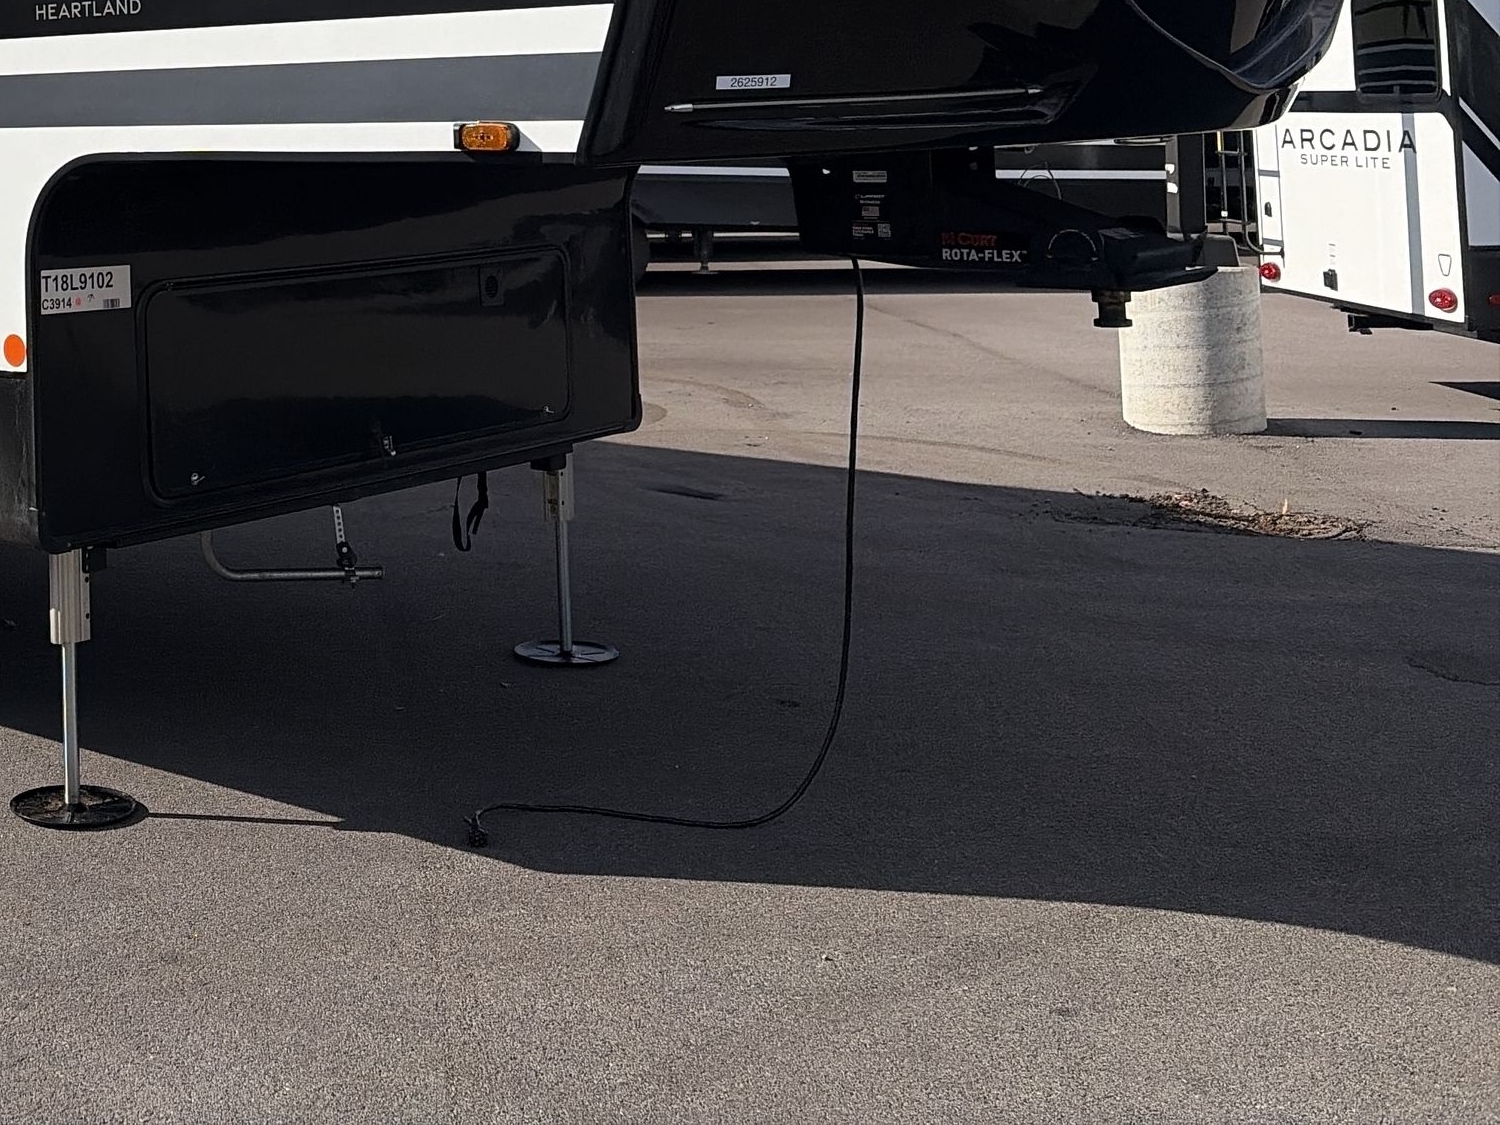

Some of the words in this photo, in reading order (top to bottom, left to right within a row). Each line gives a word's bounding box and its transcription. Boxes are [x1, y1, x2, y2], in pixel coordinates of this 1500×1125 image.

[730, 76, 777, 88] 2625912
[1281, 128, 1417, 154] ARCADIA
[1300, 153, 1349, 167] SUPER
[1355, 156, 1391, 169] LITE
[42, 271, 114, 293] T18L9102
[42, 297, 72, 310] C3914
